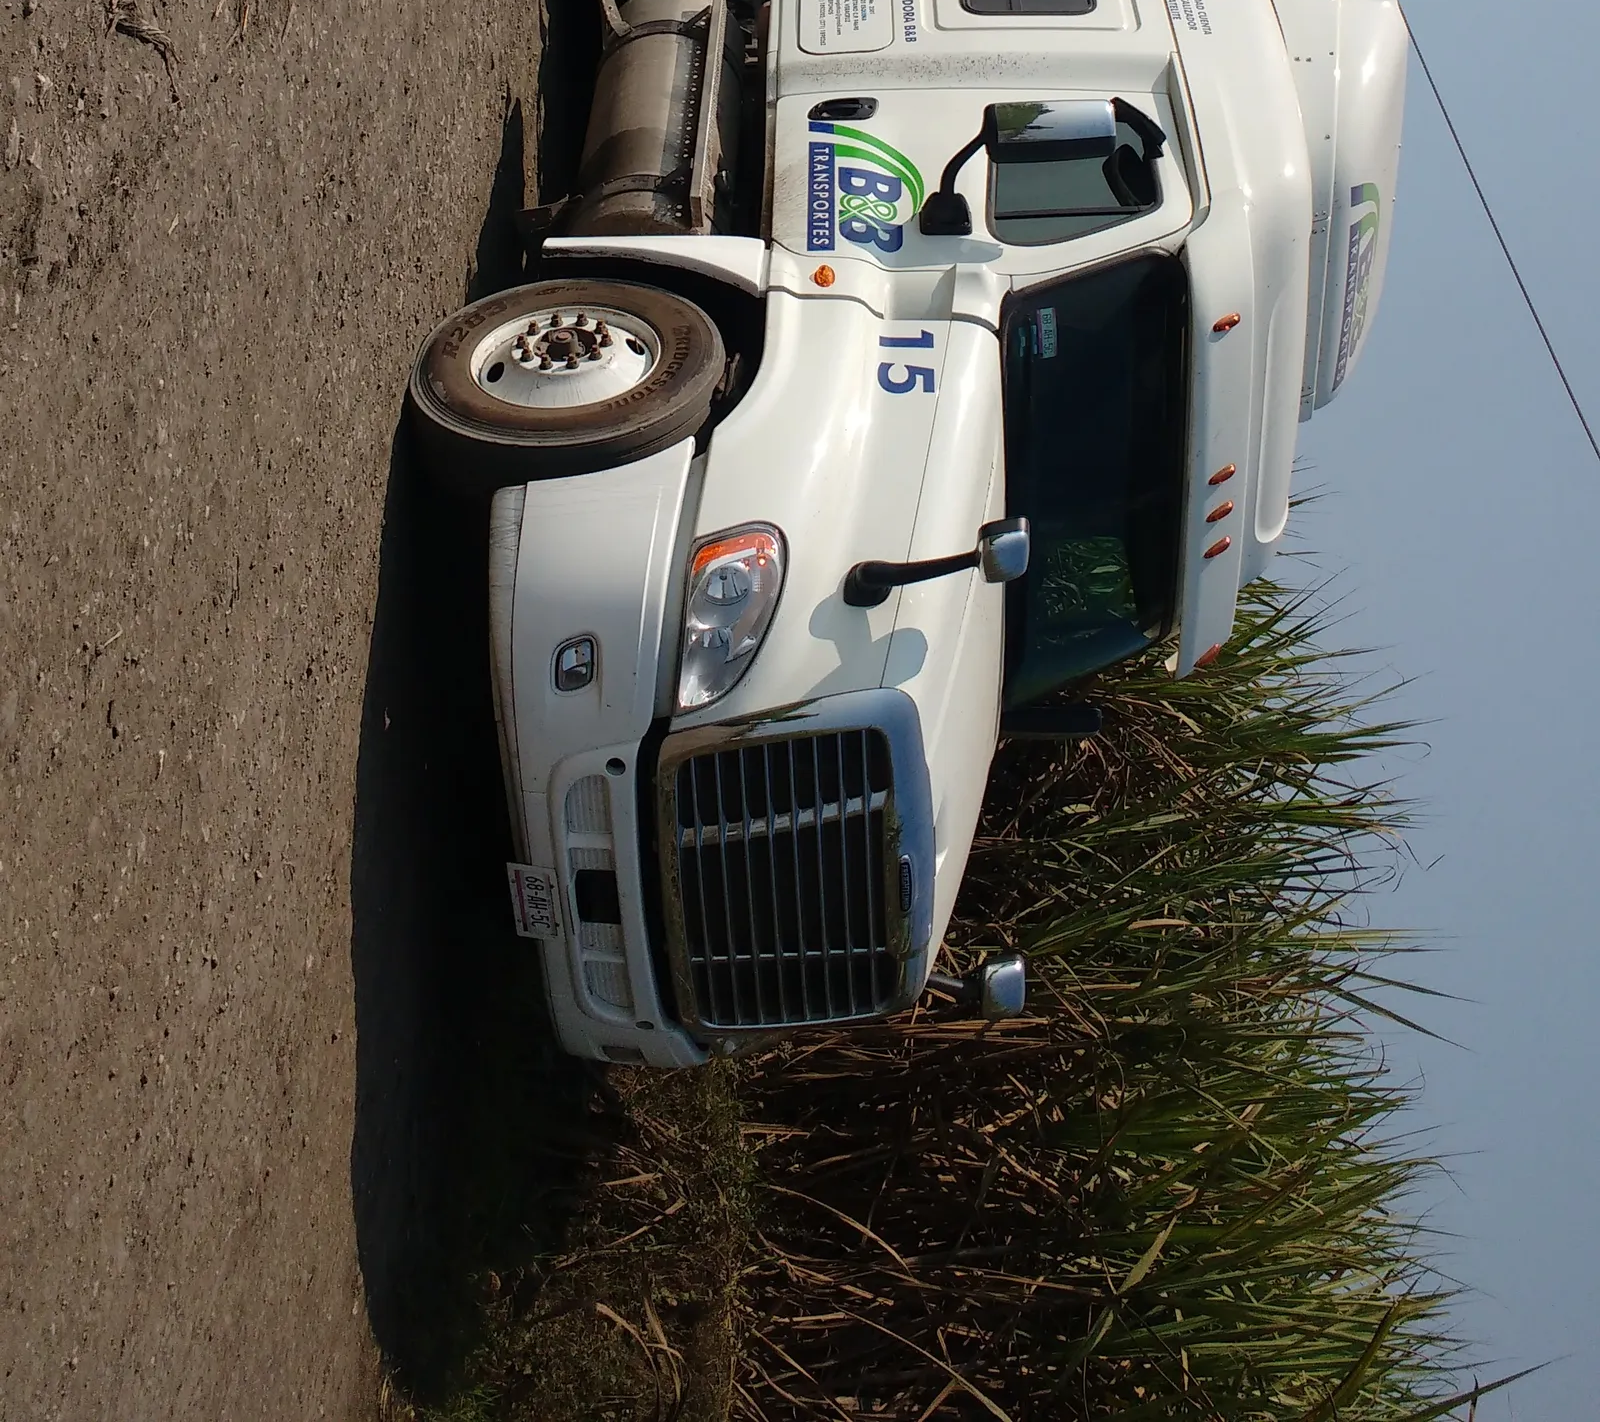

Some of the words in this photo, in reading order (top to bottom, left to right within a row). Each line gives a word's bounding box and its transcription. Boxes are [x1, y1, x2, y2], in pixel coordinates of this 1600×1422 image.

[904, 25, 917, 42] B&B
[1198, 12, 1212, 35] CUENTA
[812, 147, 829, 245] TRANSPORTES
[838, 167, 904, 253] B&B
[1336, 230, 1360, 381] TRANSPORTES
[1349, 237, 1374, 357] B&B
[877, 329, 935, 394] 15
[526, 876, 550, 928] 68-AH-5C
